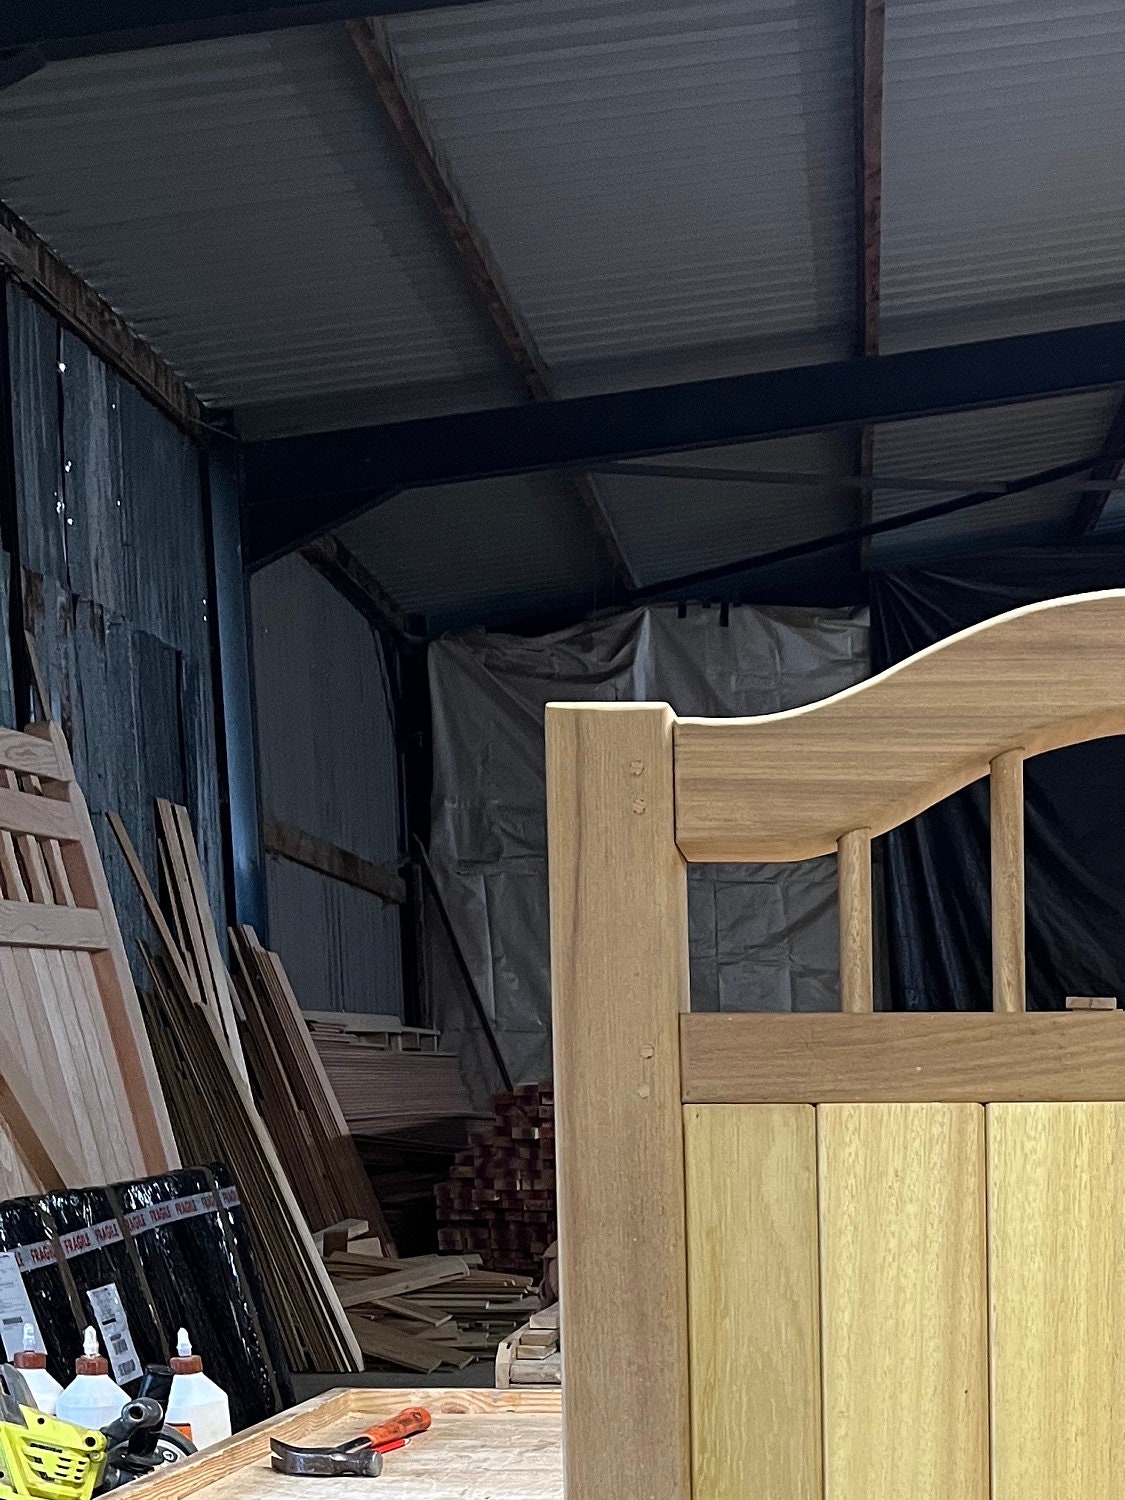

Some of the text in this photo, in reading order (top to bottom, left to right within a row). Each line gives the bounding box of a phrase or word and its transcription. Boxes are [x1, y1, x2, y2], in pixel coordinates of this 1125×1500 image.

[63, 1231, 91, 1254] FRAGILE
[94, 1223, 120, 1241] FRAGILE
[127, 1213, 147, 1233] AGILE
[149, 1204, 172, 1222] FRAGILE
[175, 1199, 198, 1216] FRAGILE
